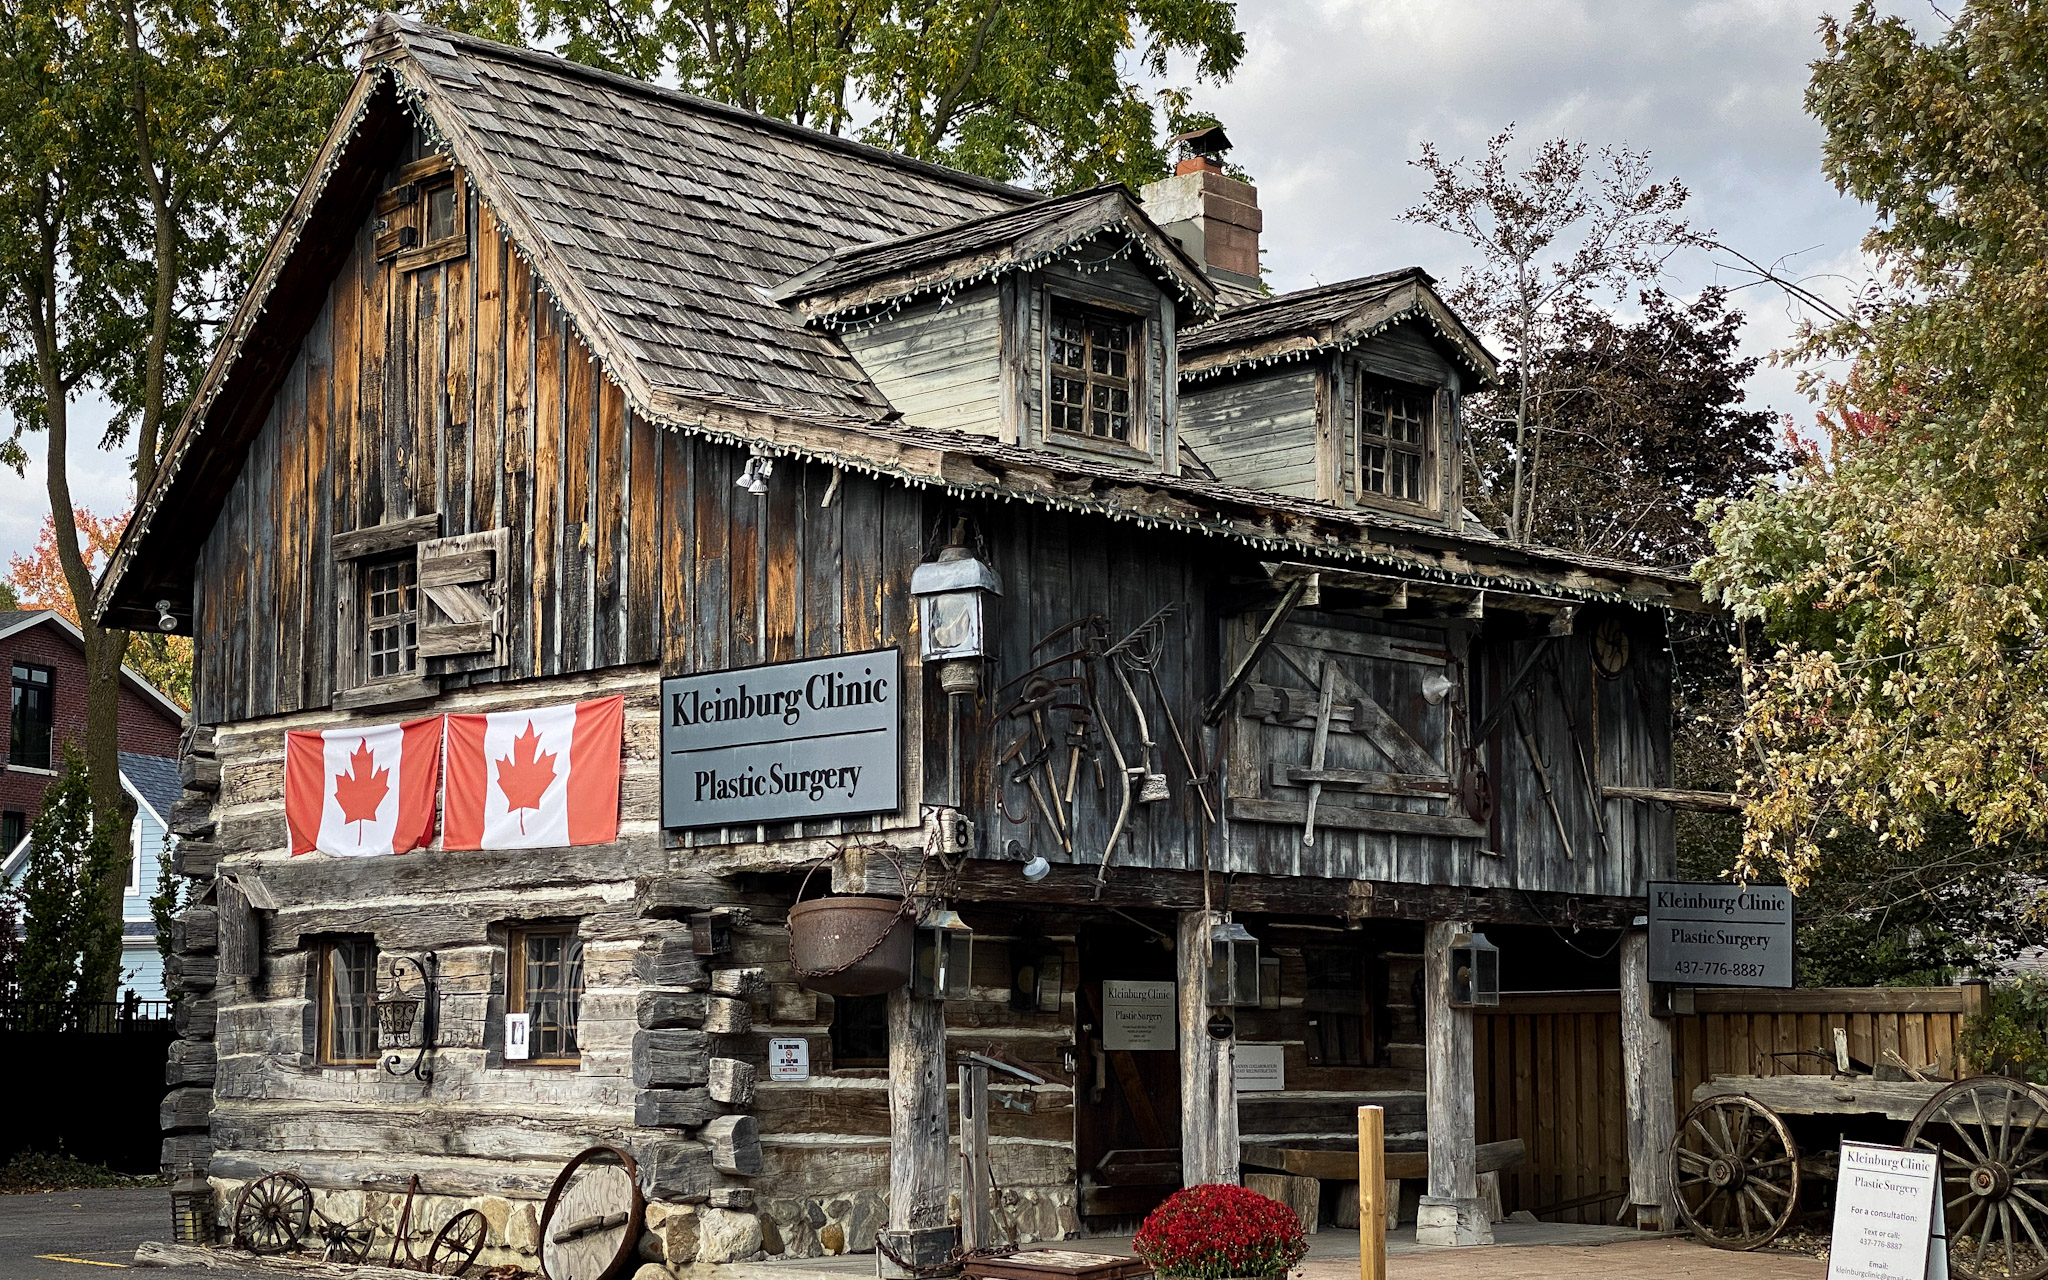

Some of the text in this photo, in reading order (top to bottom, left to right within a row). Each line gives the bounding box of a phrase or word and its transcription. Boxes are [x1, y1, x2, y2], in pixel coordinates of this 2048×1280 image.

[671, 668, 888, 727] Kleinburg Clinic
[694, 762, 862, 801] Plastic Surgery
[956, 820, 968, 847] 8
[1657, 891, 1785, 915] Kleinburg Clinic
[1671, 928, 1771, 950] Plastic Surgery
[1675, 961, 1765, 977] 437-776-8887
[1108, 987, 1170, 1002] Kleinburg Clinic
[1115, 1010, 1162, 1023] Plastic Surgery
[1847, 1151, 1930, 1172] Kleinburg Clinic
[1855, 1176, 1919, 1197] Plastic Surgery
[1851, 1206, 1862, 1215] For
[1870, 1210, 1918, 1222] consultation:
[1864, 1228, 1878, 1237] Text
[1859, 1238, 1903, 1251] 437-776-8887
[1868, 1260, 1889, 1270] Email:
